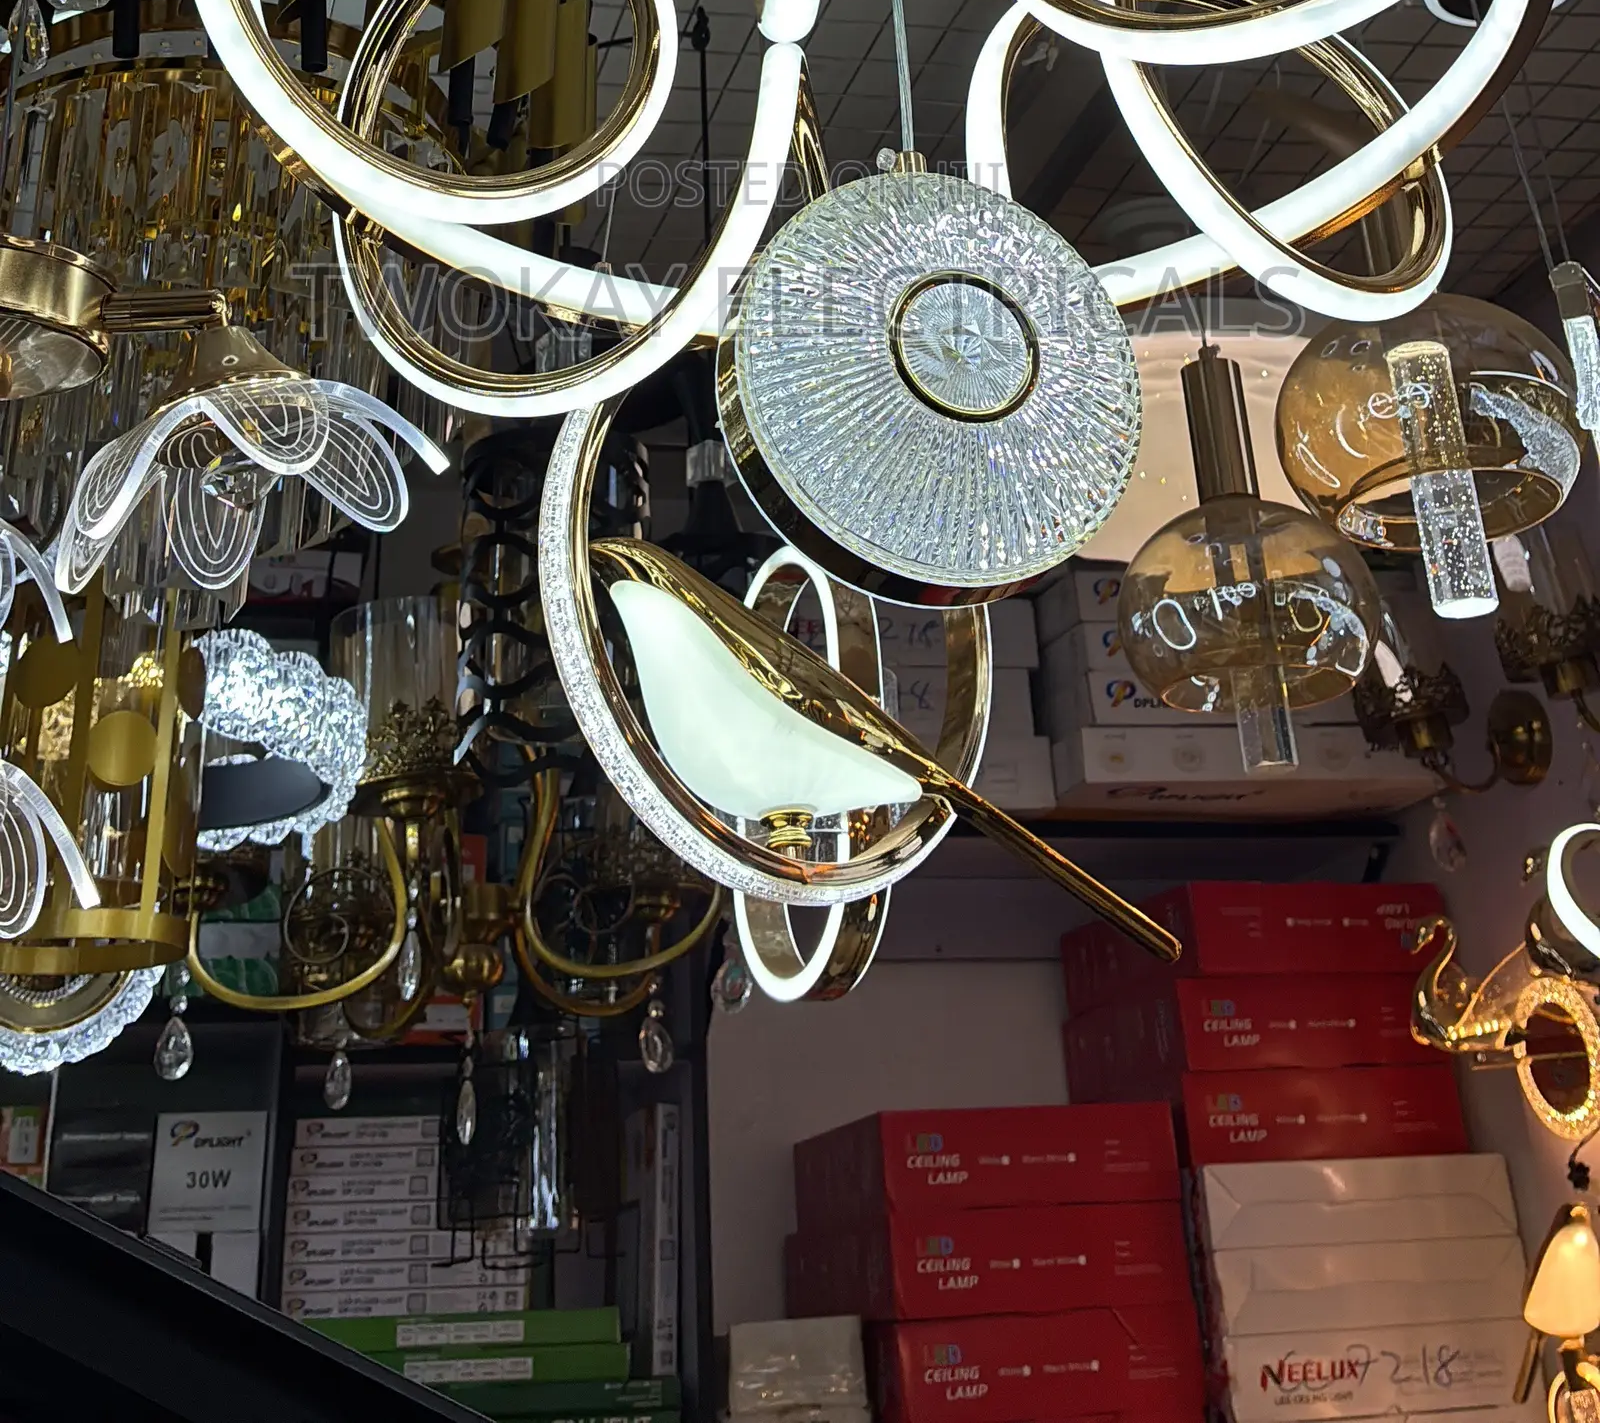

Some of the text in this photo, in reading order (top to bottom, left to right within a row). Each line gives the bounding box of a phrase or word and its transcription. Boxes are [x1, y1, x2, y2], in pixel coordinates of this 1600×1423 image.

[1203, 1018, 1253, 1032] CEILING
[1223, 1034, 1261, 1047] LAMP
[1208, 1113, 1260, 1128] CEILING
[1229, 1129, 1268, 1144] LAMP
[906, 1153, 961, 1169] CEILING
[185, 1169, 232, 1189] 30W
[927, 1170, 969, 1185] LAMP
[916, 1257, 972, 1274] CEILING
[938, 1275, 979, 1290] LAMP
[924, 1364, 981, 1384] CEILING
[1259, 1358, 1360, 1393] NEELUX
[945, 1384, 989, 1401] LAMP
